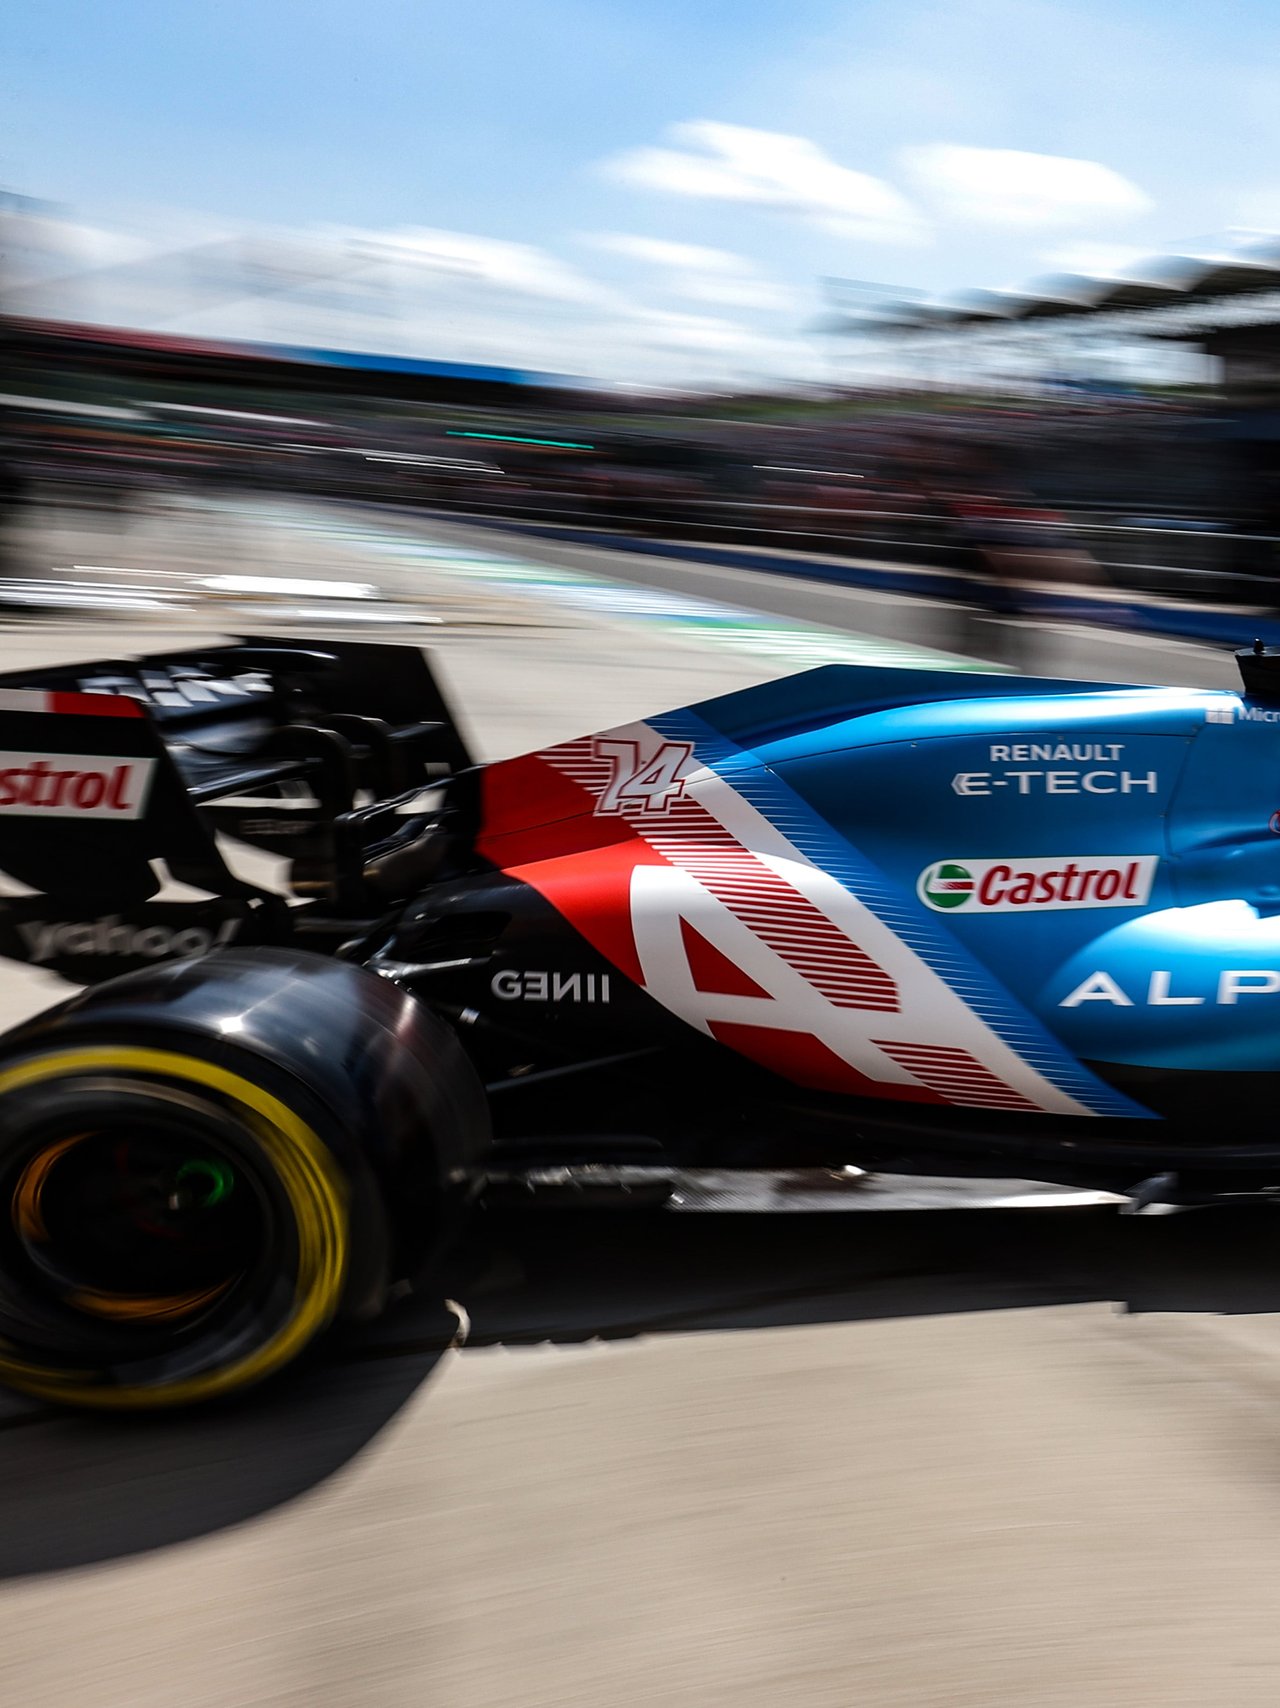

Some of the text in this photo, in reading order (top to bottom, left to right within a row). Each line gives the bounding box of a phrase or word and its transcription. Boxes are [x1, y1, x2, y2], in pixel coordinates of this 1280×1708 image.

[989, 744, 1125, 762] RENAULT
[591, 735, 695, 817] 14
[951, 770, 1158, 796] E-TECH
[978, 862, 1140, 906] Castrol
